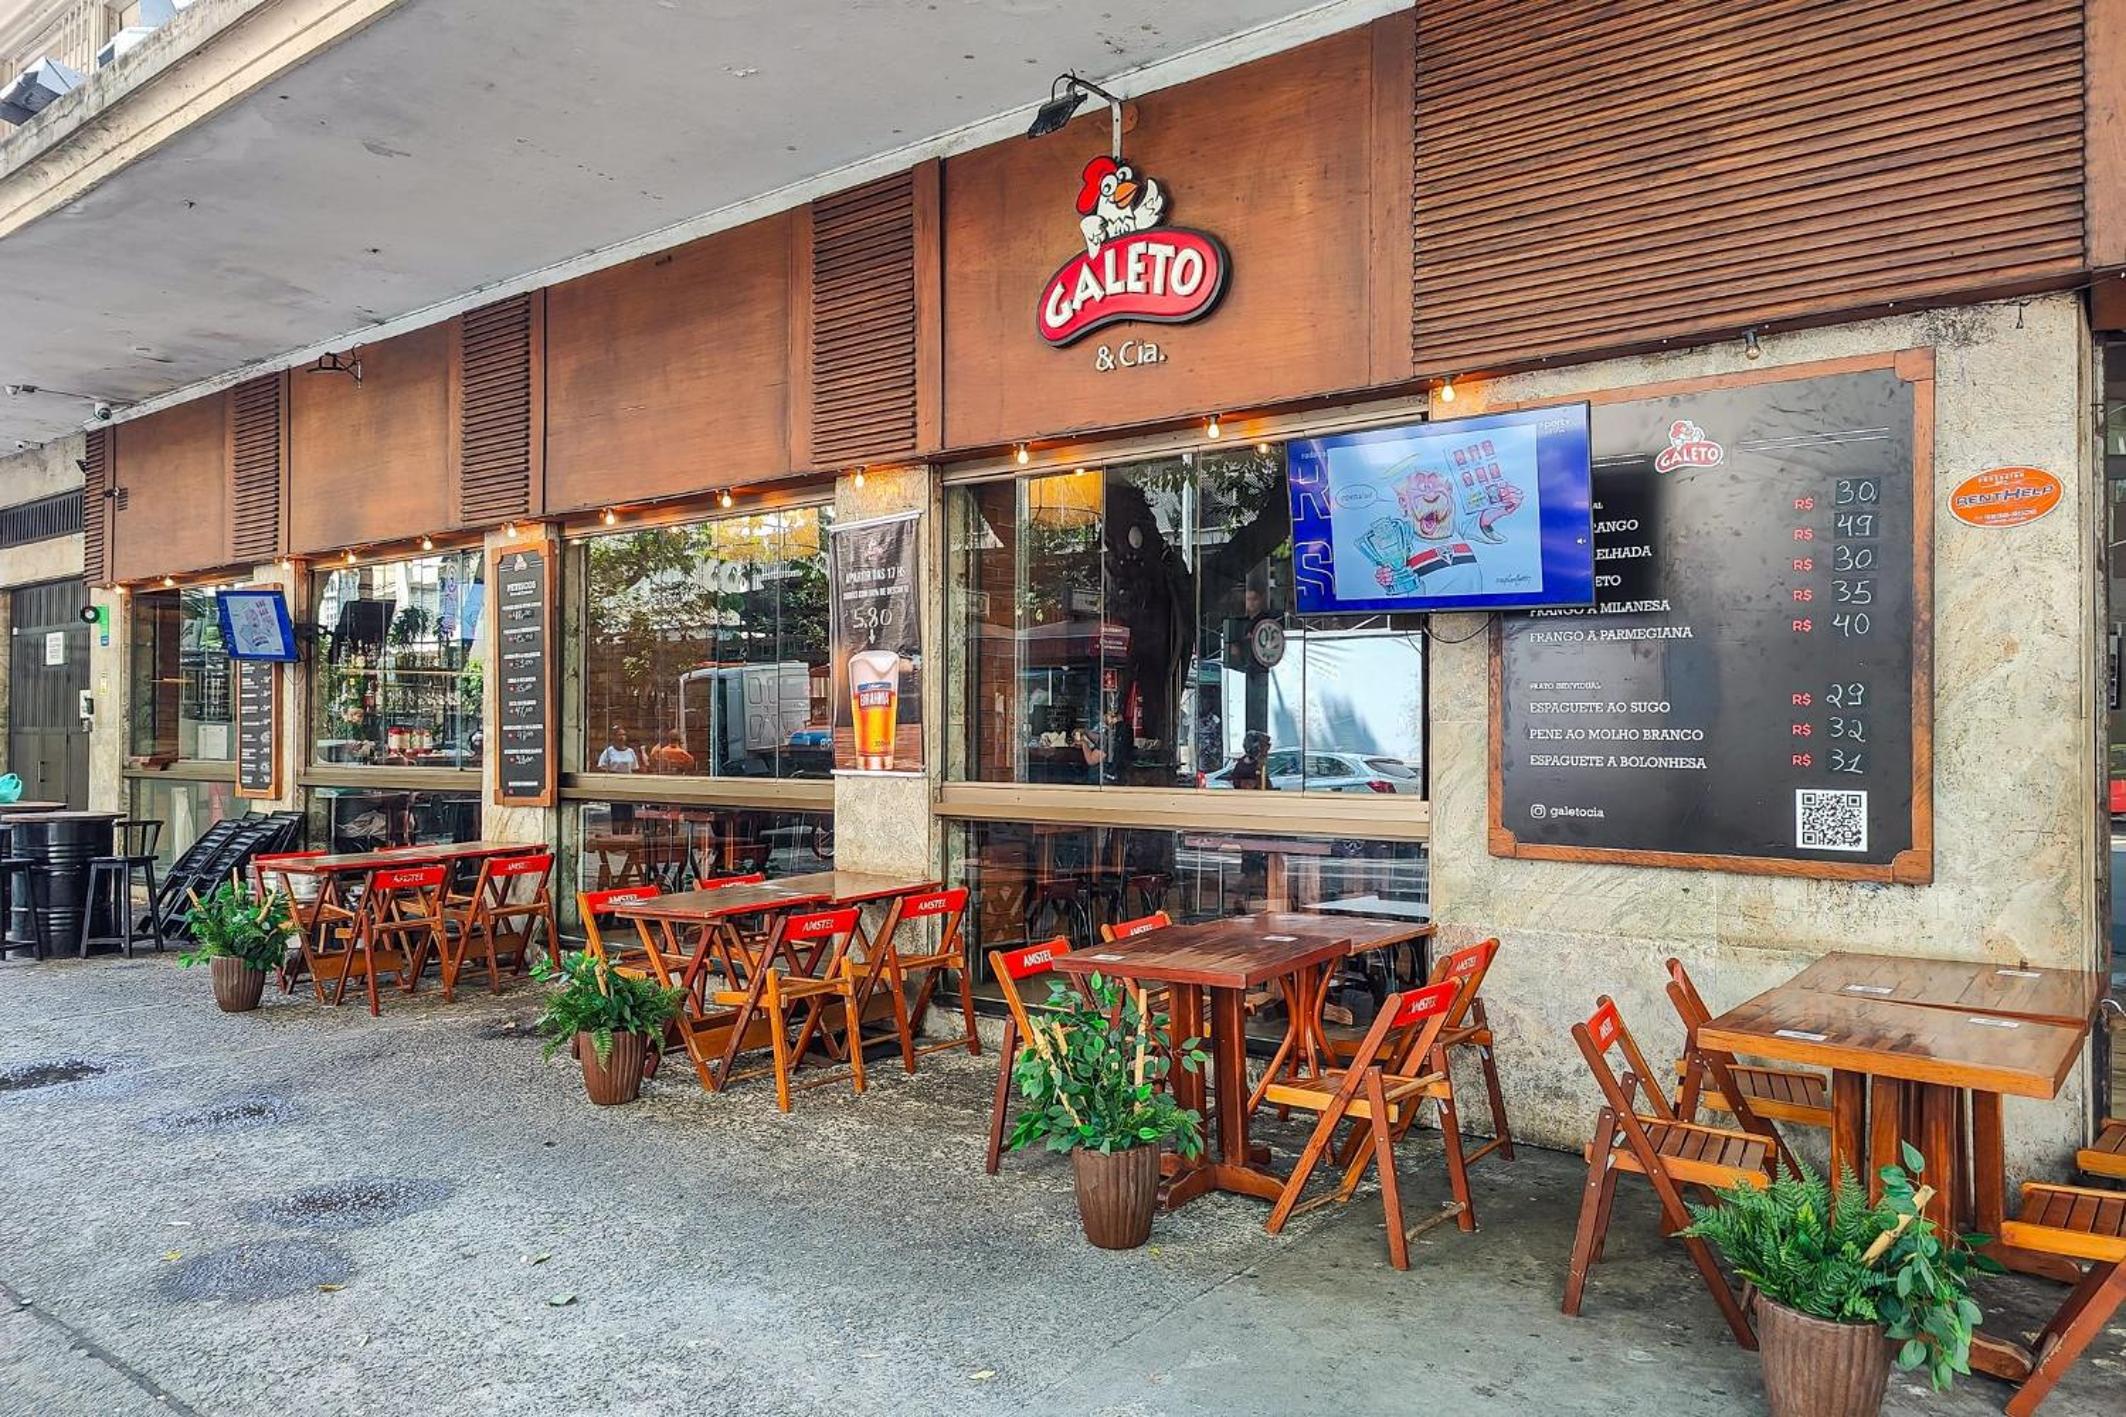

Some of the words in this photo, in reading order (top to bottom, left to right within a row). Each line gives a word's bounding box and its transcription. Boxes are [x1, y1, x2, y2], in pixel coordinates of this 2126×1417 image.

[1045, 241, 1204, 328] GALETO
[1095, 346, 1116, 371] &
[1119, 340, 1167, 367] Cia.
[1660, 446, 1720, 467] GALETO
[1794, 498, 1814, 511] R$
[1793, 528, 1814, 542] R$
[1837, 515, 1873, 537] 49
[1793, 558, 1813, 572] R$
[1835, 545, 1873, 572] 30
[1793, 589, 1812, 602] R$
[1832, 580, 1872, 605] 35
[1600, 600, 1671, 614] MILANESA
[1792, 619, 1812, 632] R$
[1832, 613, 1870, 637] 40
[1530, 630, 1584, 643] FRANGO
[1587, 631, 1597, 642] A
[1600, 626, 1694, 641] PARMEGIANA
[1555, 681, 1601, 690] INDIVIDUAL
[1792, 693, 1812, 706] R$
[1826, 683, 1865, 709] 29
[1529, 702, 1604, 713] ESPAGUETE
[1606, 702, 1627, 713] AO
[1630, 701, 1671, 713] SUGO
[1529, 729, 1563, 740] PENE
[1565, 729, 1585, 740] AO
[1588, 729, 1639, 741] MOLHO
[1642, 729, 1704, 741] BRANCO
[1792, 723, 1812, 736] R$
[1829, 716, 1866, 743] 32
[1530, 755, 1604, 767] ESPAGUETE
[1606, 756, 1618, 767] A
[1620, 756, 1707, 769] BOLONHESA
[1792, 753, 1812, 767] R$
[1831, 749, 1864, 774] 31
[1550, 806, 1605, 818] galetocia
[917, 898, 947, 911] AMSTEL
[803, 919, 834, 932] AMSTEL
[1023, 950, 1054, 967] AMSTEL
